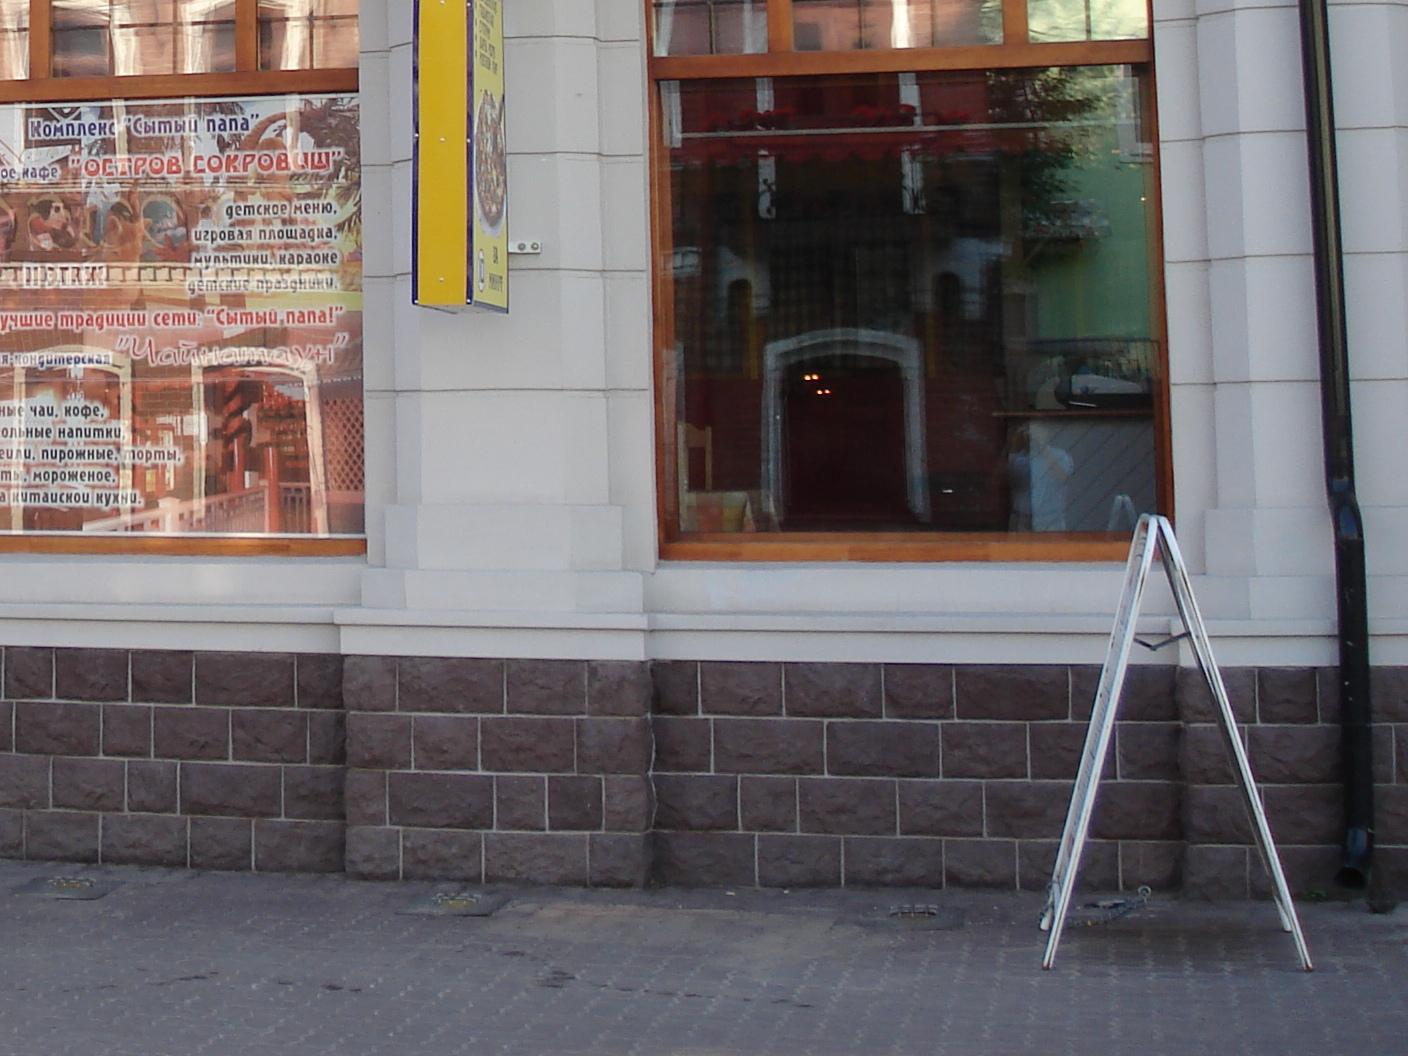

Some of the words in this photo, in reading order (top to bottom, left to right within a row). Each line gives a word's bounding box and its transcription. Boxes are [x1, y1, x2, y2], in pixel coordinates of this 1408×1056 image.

[30, 119, 116, 139] Комплекс
[22, 165, 59, 182] кафе
[225, 202, 288, 220] детское
[293, 201, 338, 216] меню,
[194, 228, 253, 244] игровая
[258, 226, 338, 243] площадка,
[278, 252, 339, 268] караоке
[60, 312, 147, 331] традиции
[64, 404, 105, 419] кофе,
[57, 426, 126, 441] напитки,
[32, 469, 116, 484] мороженое,
